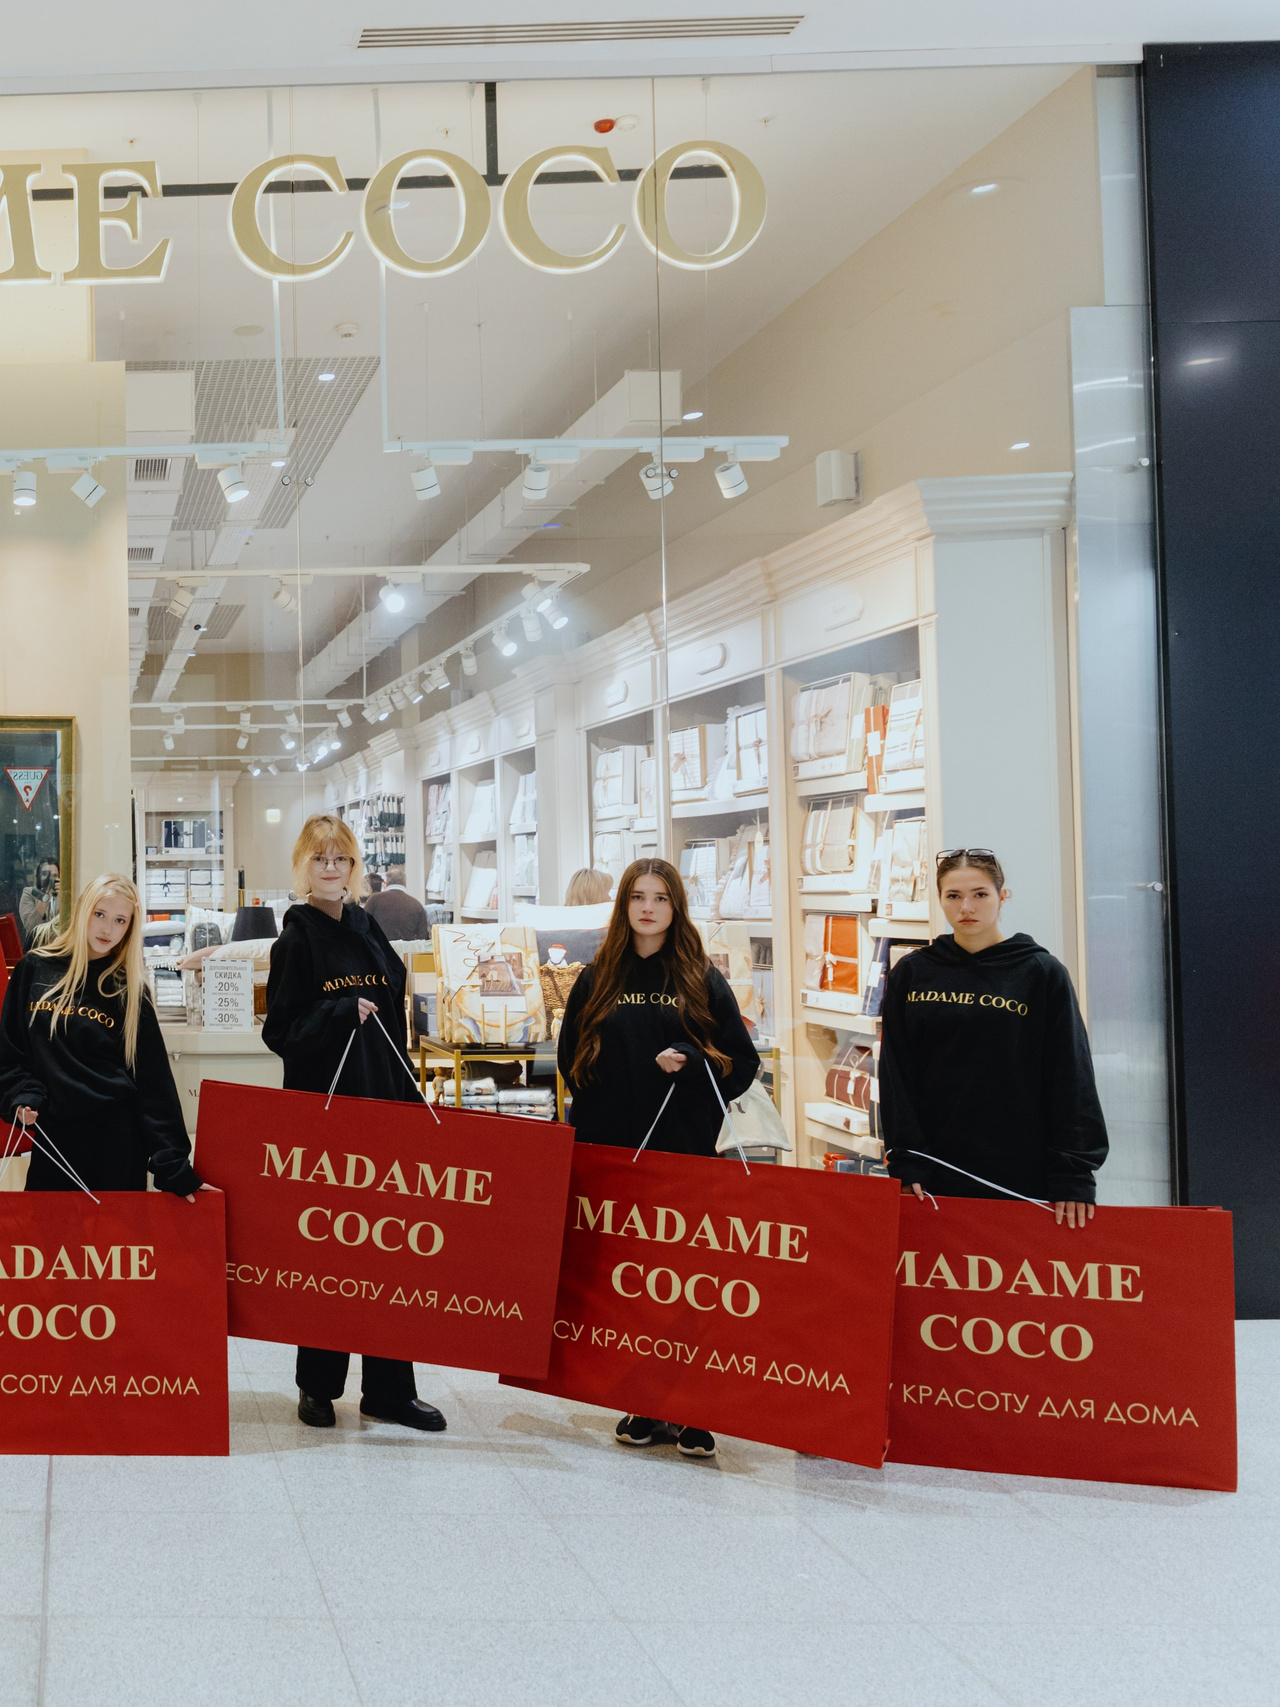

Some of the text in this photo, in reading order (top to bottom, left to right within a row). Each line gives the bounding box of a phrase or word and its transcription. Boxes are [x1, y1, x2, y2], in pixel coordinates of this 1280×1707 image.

[227, 139, 768, 283] COCO
[214, 971, 242, 979] СКИДКА
[214, 981, 239, 992] -20%
[77, 1006, 115, 1029] COCO
[214, 997, 239, 1007] -25%
[214, 1013, 239, 1023] -30%
[907, 990, 1028, 1016] MADAME COCO
[260, 1142, 493, 1206] MADAME
[297, 1206, 445, 1256] COCO
[573, 1196, 809, 1264] MADAME
[226, 1263, 523, 1321] ЕСУ КРАСОТУ ДЛЯ ДОМА
[611, 1261, 760, 1318] COCO
[553, 1320, 851, 1395] СУ КРАСОТУ ДЛЯ ДОМА
[920, 1313, 1094, 1362] COCO
[69, 1375, 116, 1397] ДЛЯ
[123, 1376, 200, 1397] ДОМА
[903, 1384, 1200, 1428] КРАСОТУ ДЛЯ ДОМА
